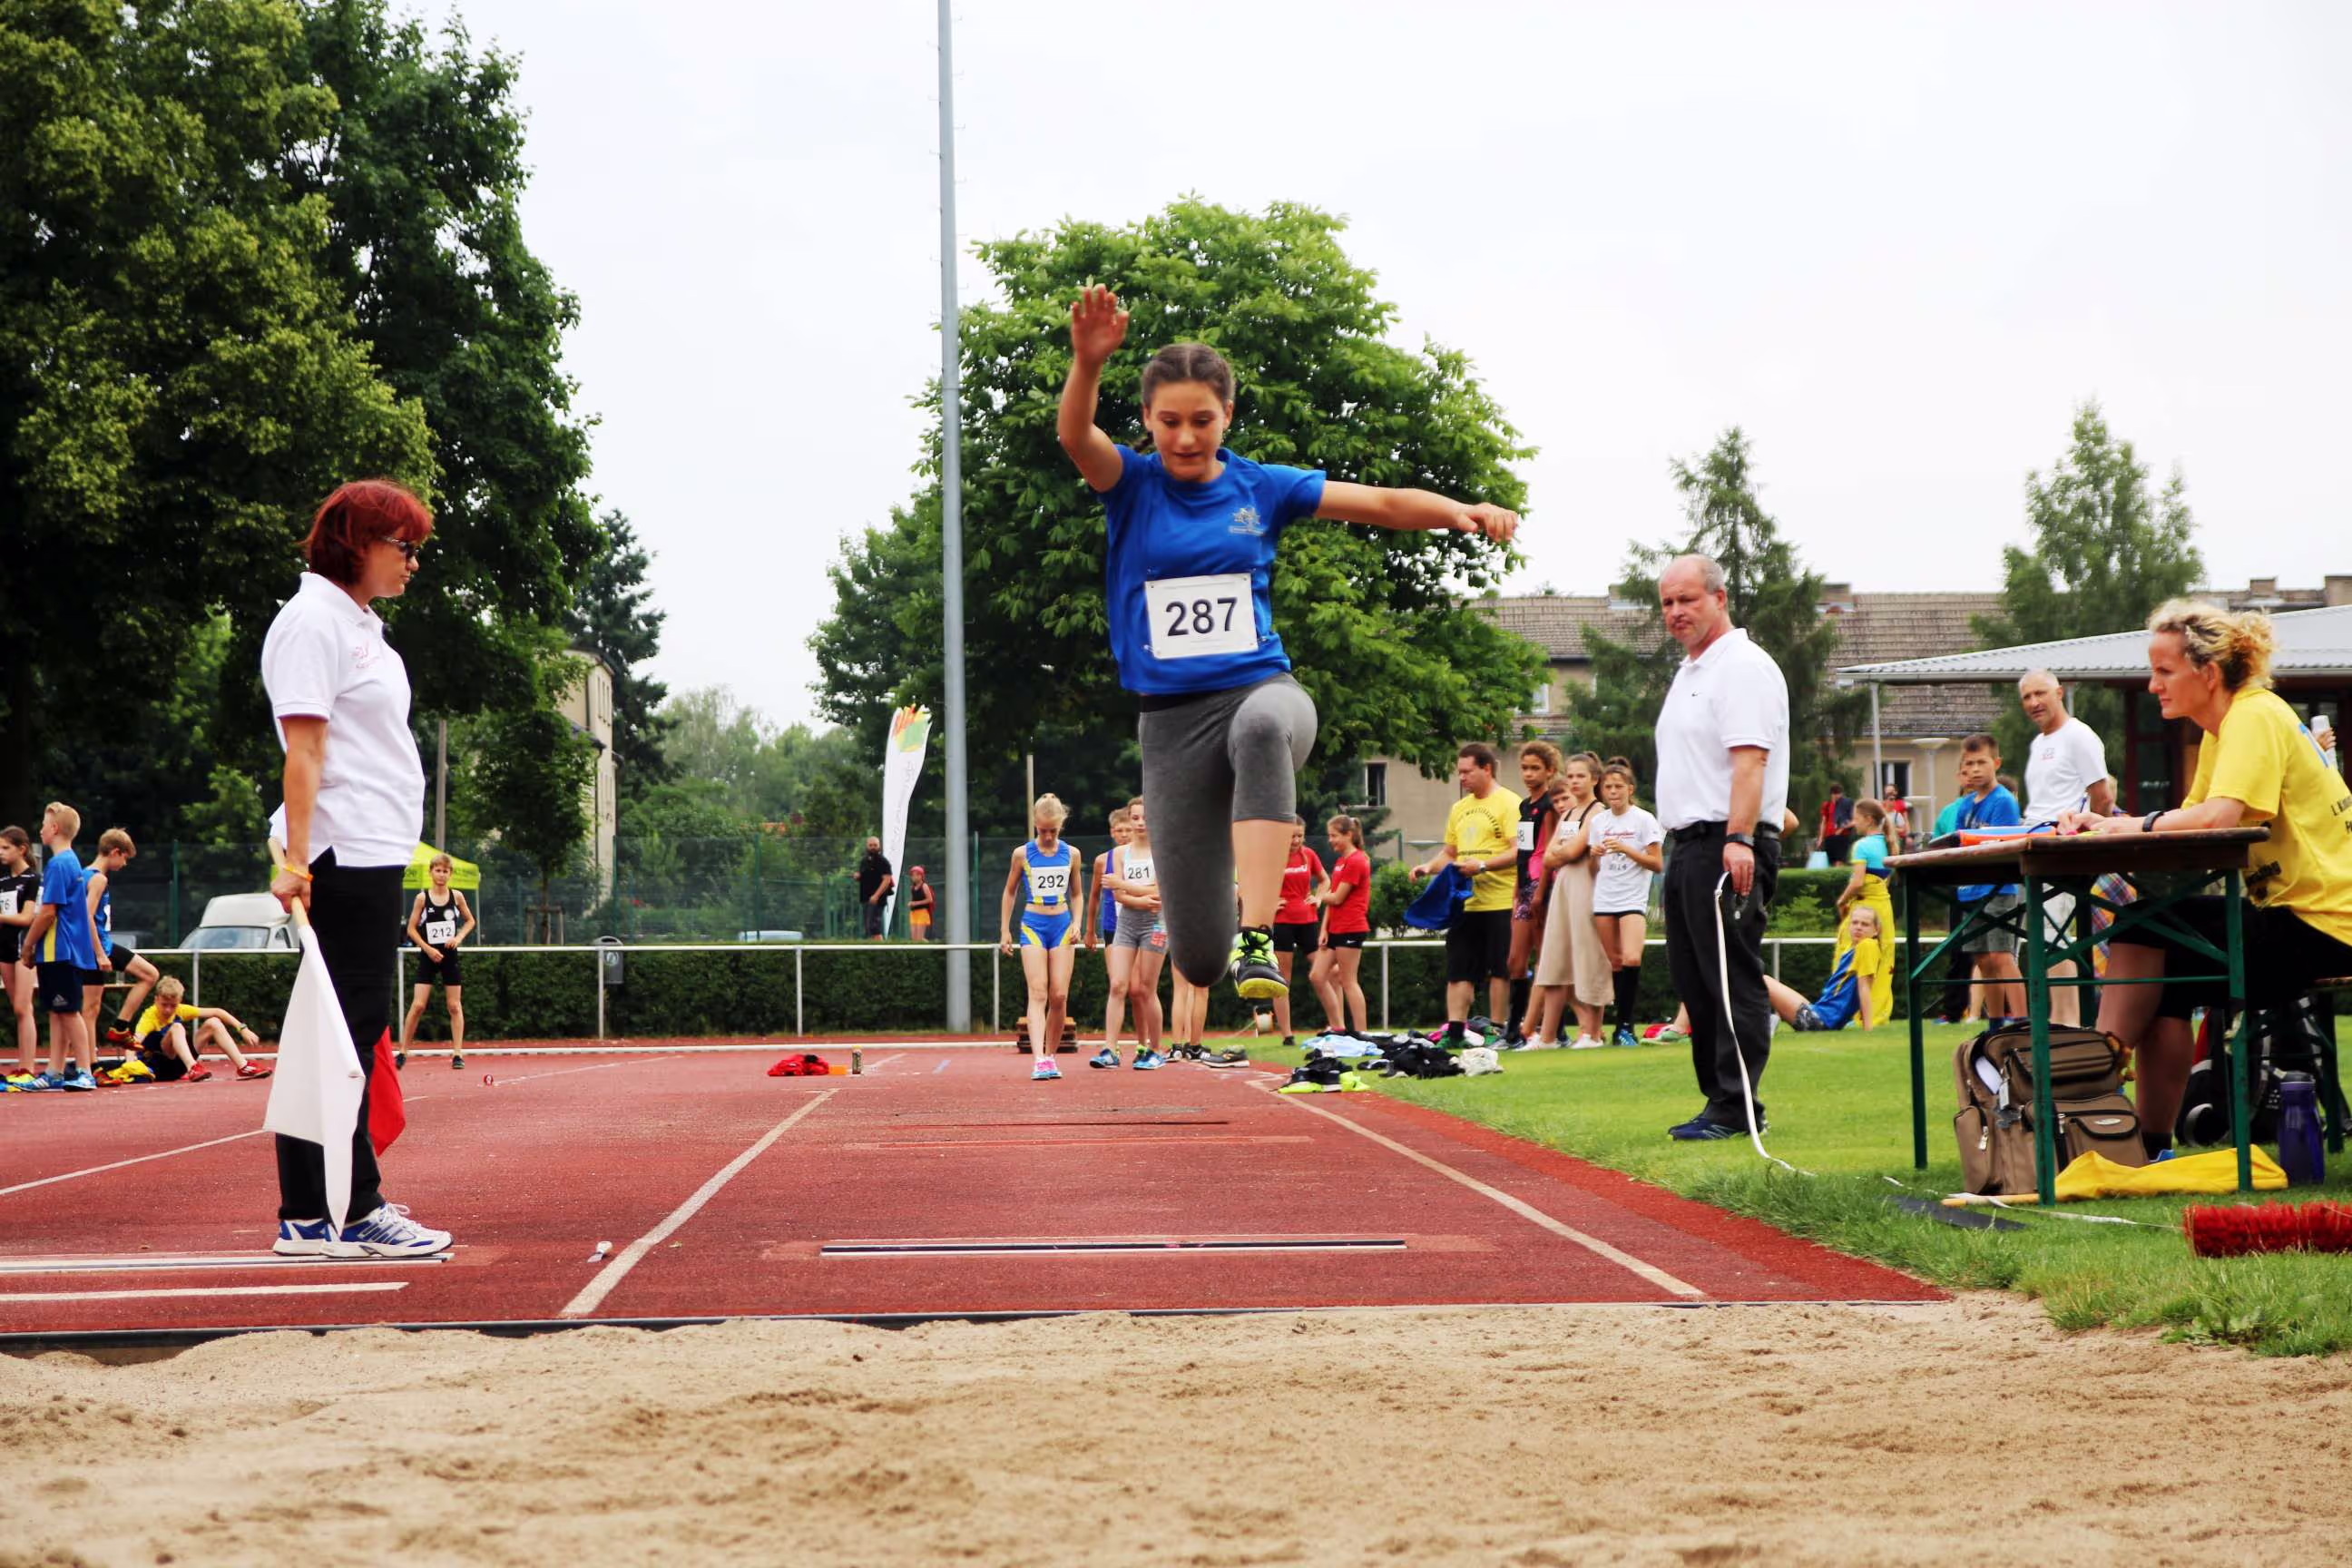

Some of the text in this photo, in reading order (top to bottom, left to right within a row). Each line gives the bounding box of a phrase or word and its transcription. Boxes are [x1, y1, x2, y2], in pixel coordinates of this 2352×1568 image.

[1165, 597, 1238, 636] 287
[1128, 867, 1150, 879] 281
[1037, 875, 1064, 889] 292
[432, 927, 452, 938] 212
